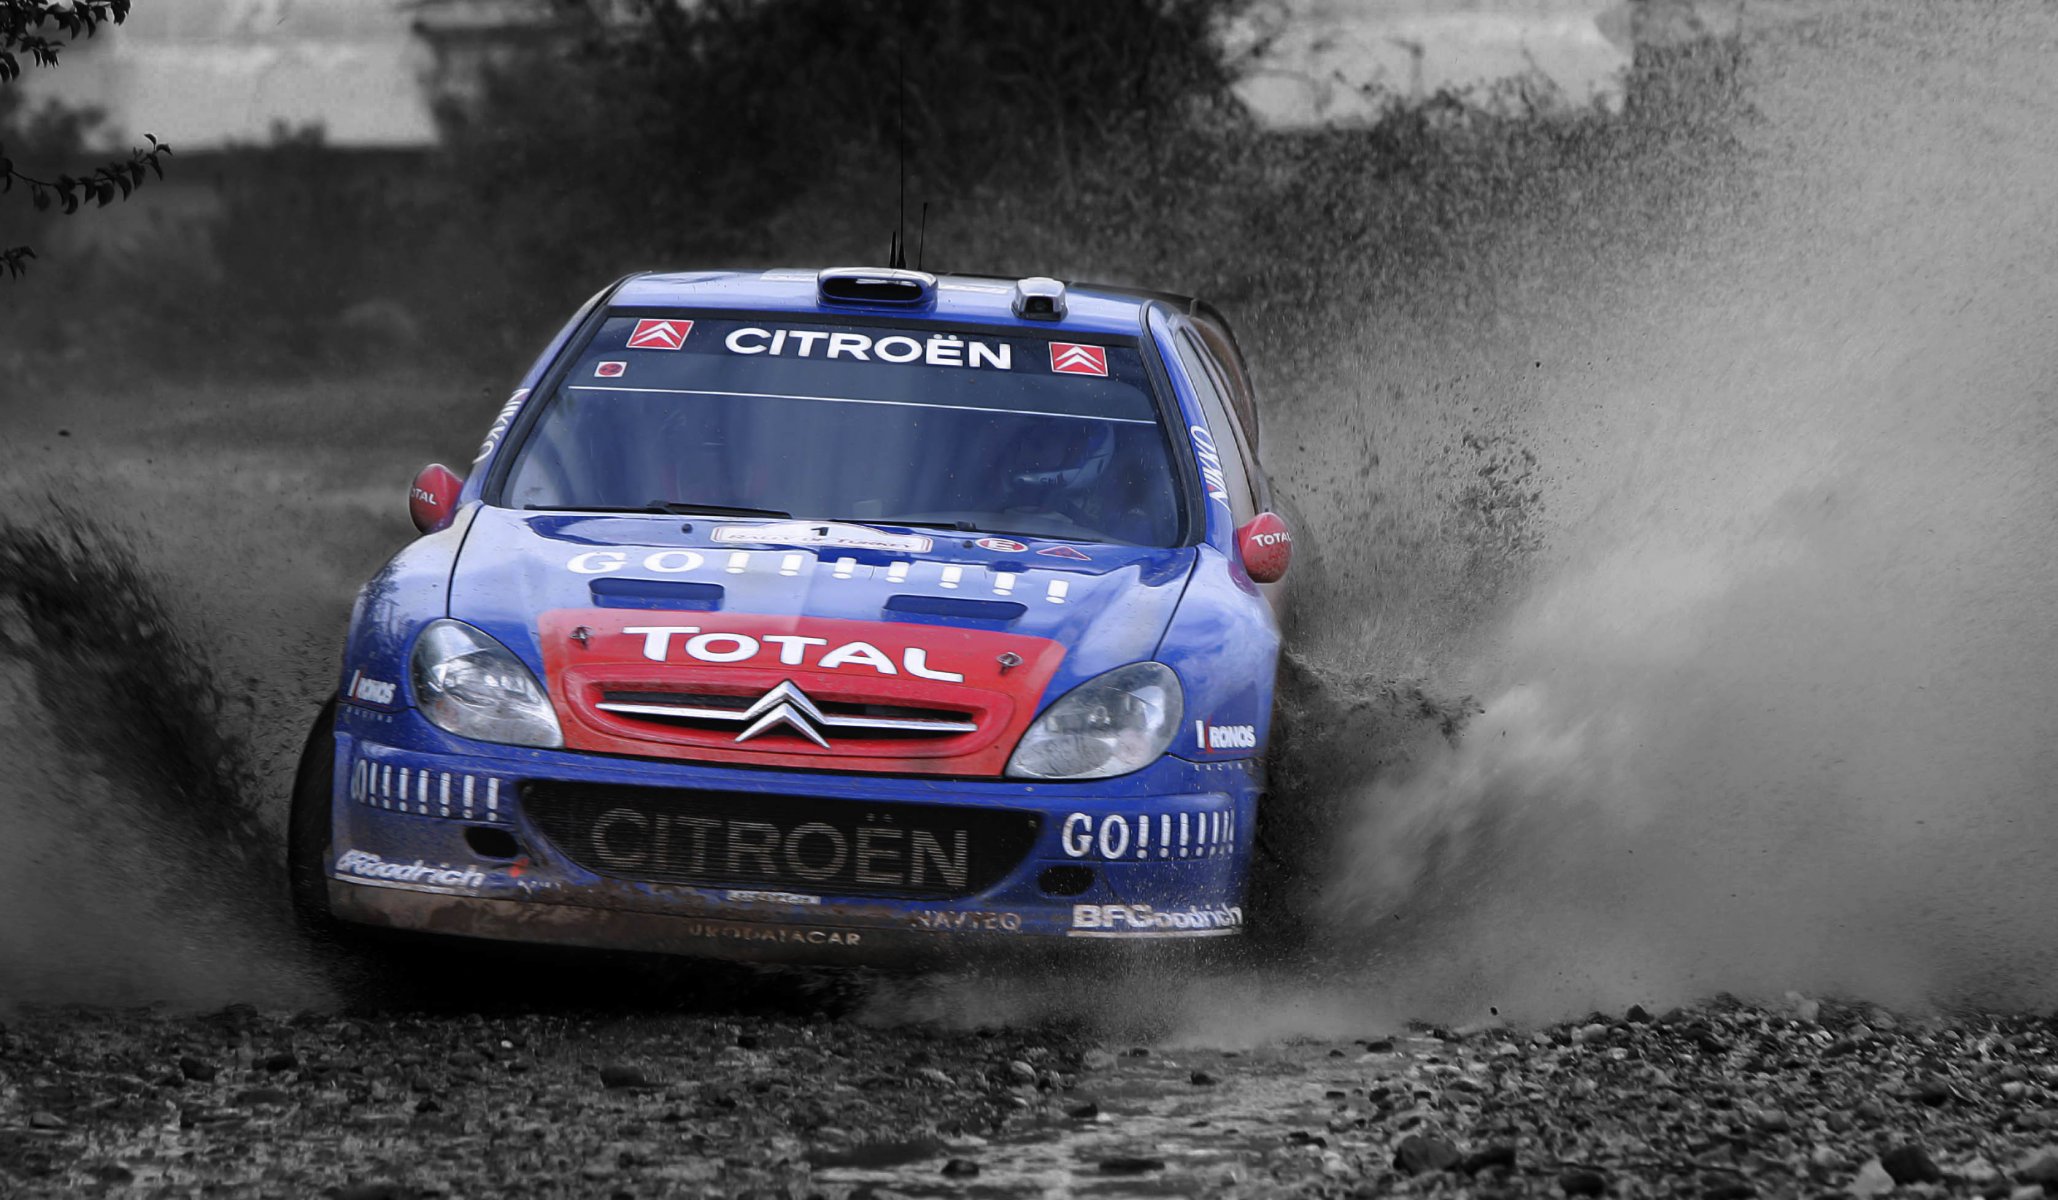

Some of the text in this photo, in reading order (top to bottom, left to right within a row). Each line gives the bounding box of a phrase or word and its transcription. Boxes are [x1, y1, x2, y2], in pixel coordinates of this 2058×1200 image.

[725, 327, 1012, 370] CITROËN
[1190, 425, 1232, 513] NIKKO
[811, 526, 829, 537] 1
[622, 625, 965, 684] TOTAL
[591, 808, 969, 888] CITROËN
[1072, 902, 1243, 928] BFGoodrich
